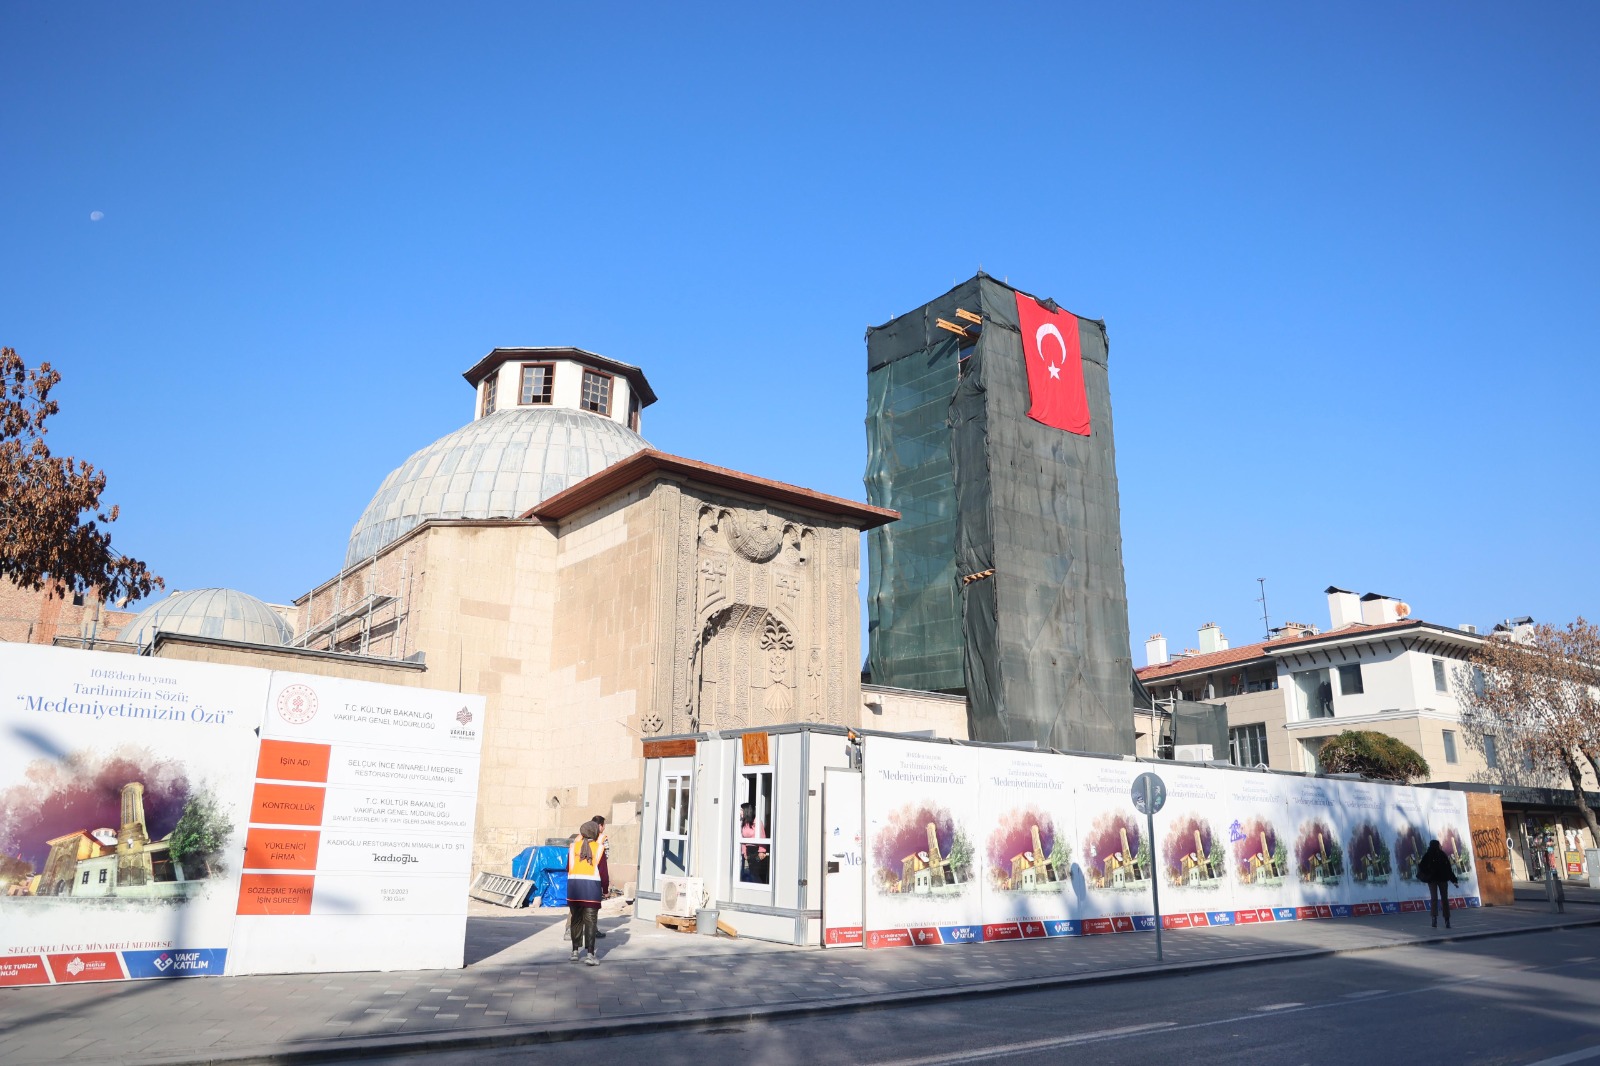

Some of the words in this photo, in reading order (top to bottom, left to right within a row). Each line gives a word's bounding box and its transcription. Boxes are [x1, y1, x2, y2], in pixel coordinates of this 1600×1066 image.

[138, 673, 151, 683] bu
[152, 675, 178, 686] yana
[73, 683, 152, 700] Tarihimizin
[360, 705, 392, 715] KÜLTÜR
[393, 708, 433, 720] BAKANLIĞI
[333, 713, 368, 723] VAKIFLAR
[368, 717, 392, 726] GENEL
[280, 756, 296, 766] İŞİN
[347, 759, 377, 769] SELÇUK
[378, 760, 396, 770] İNCE
[430, 766, 464, 776] MEDRESE
[262, 801, 316, 811] KONTROLLÜK
[380, 798, 409, 807] KÜLTÜR
[354, 807, 386, 815] VAKIFLAR
[264, 841, 306, 851] YÜKLENİCİ
[326, 838, 361, 848] KADIOĞLU
[363, 839, 411, 847] RESTORASYON
[270, 851, 296, 861] FİRMA
[247, 887, 286, 895] SÖZLEŞME
[256, 896, 272, 904] İŞİN
[8, 944, 59, 955] SELÇUKLU
[61, 943, 84, 952] İNCE
[86, 940, 131, 951] MİNARELİ
[132, 940, 173, 951] MEDRESE
[174, 952, 200, 962] VAKIF
[14, 962, 38, 970] TURİZM
[173, 960, 209, 970] KATILIM
